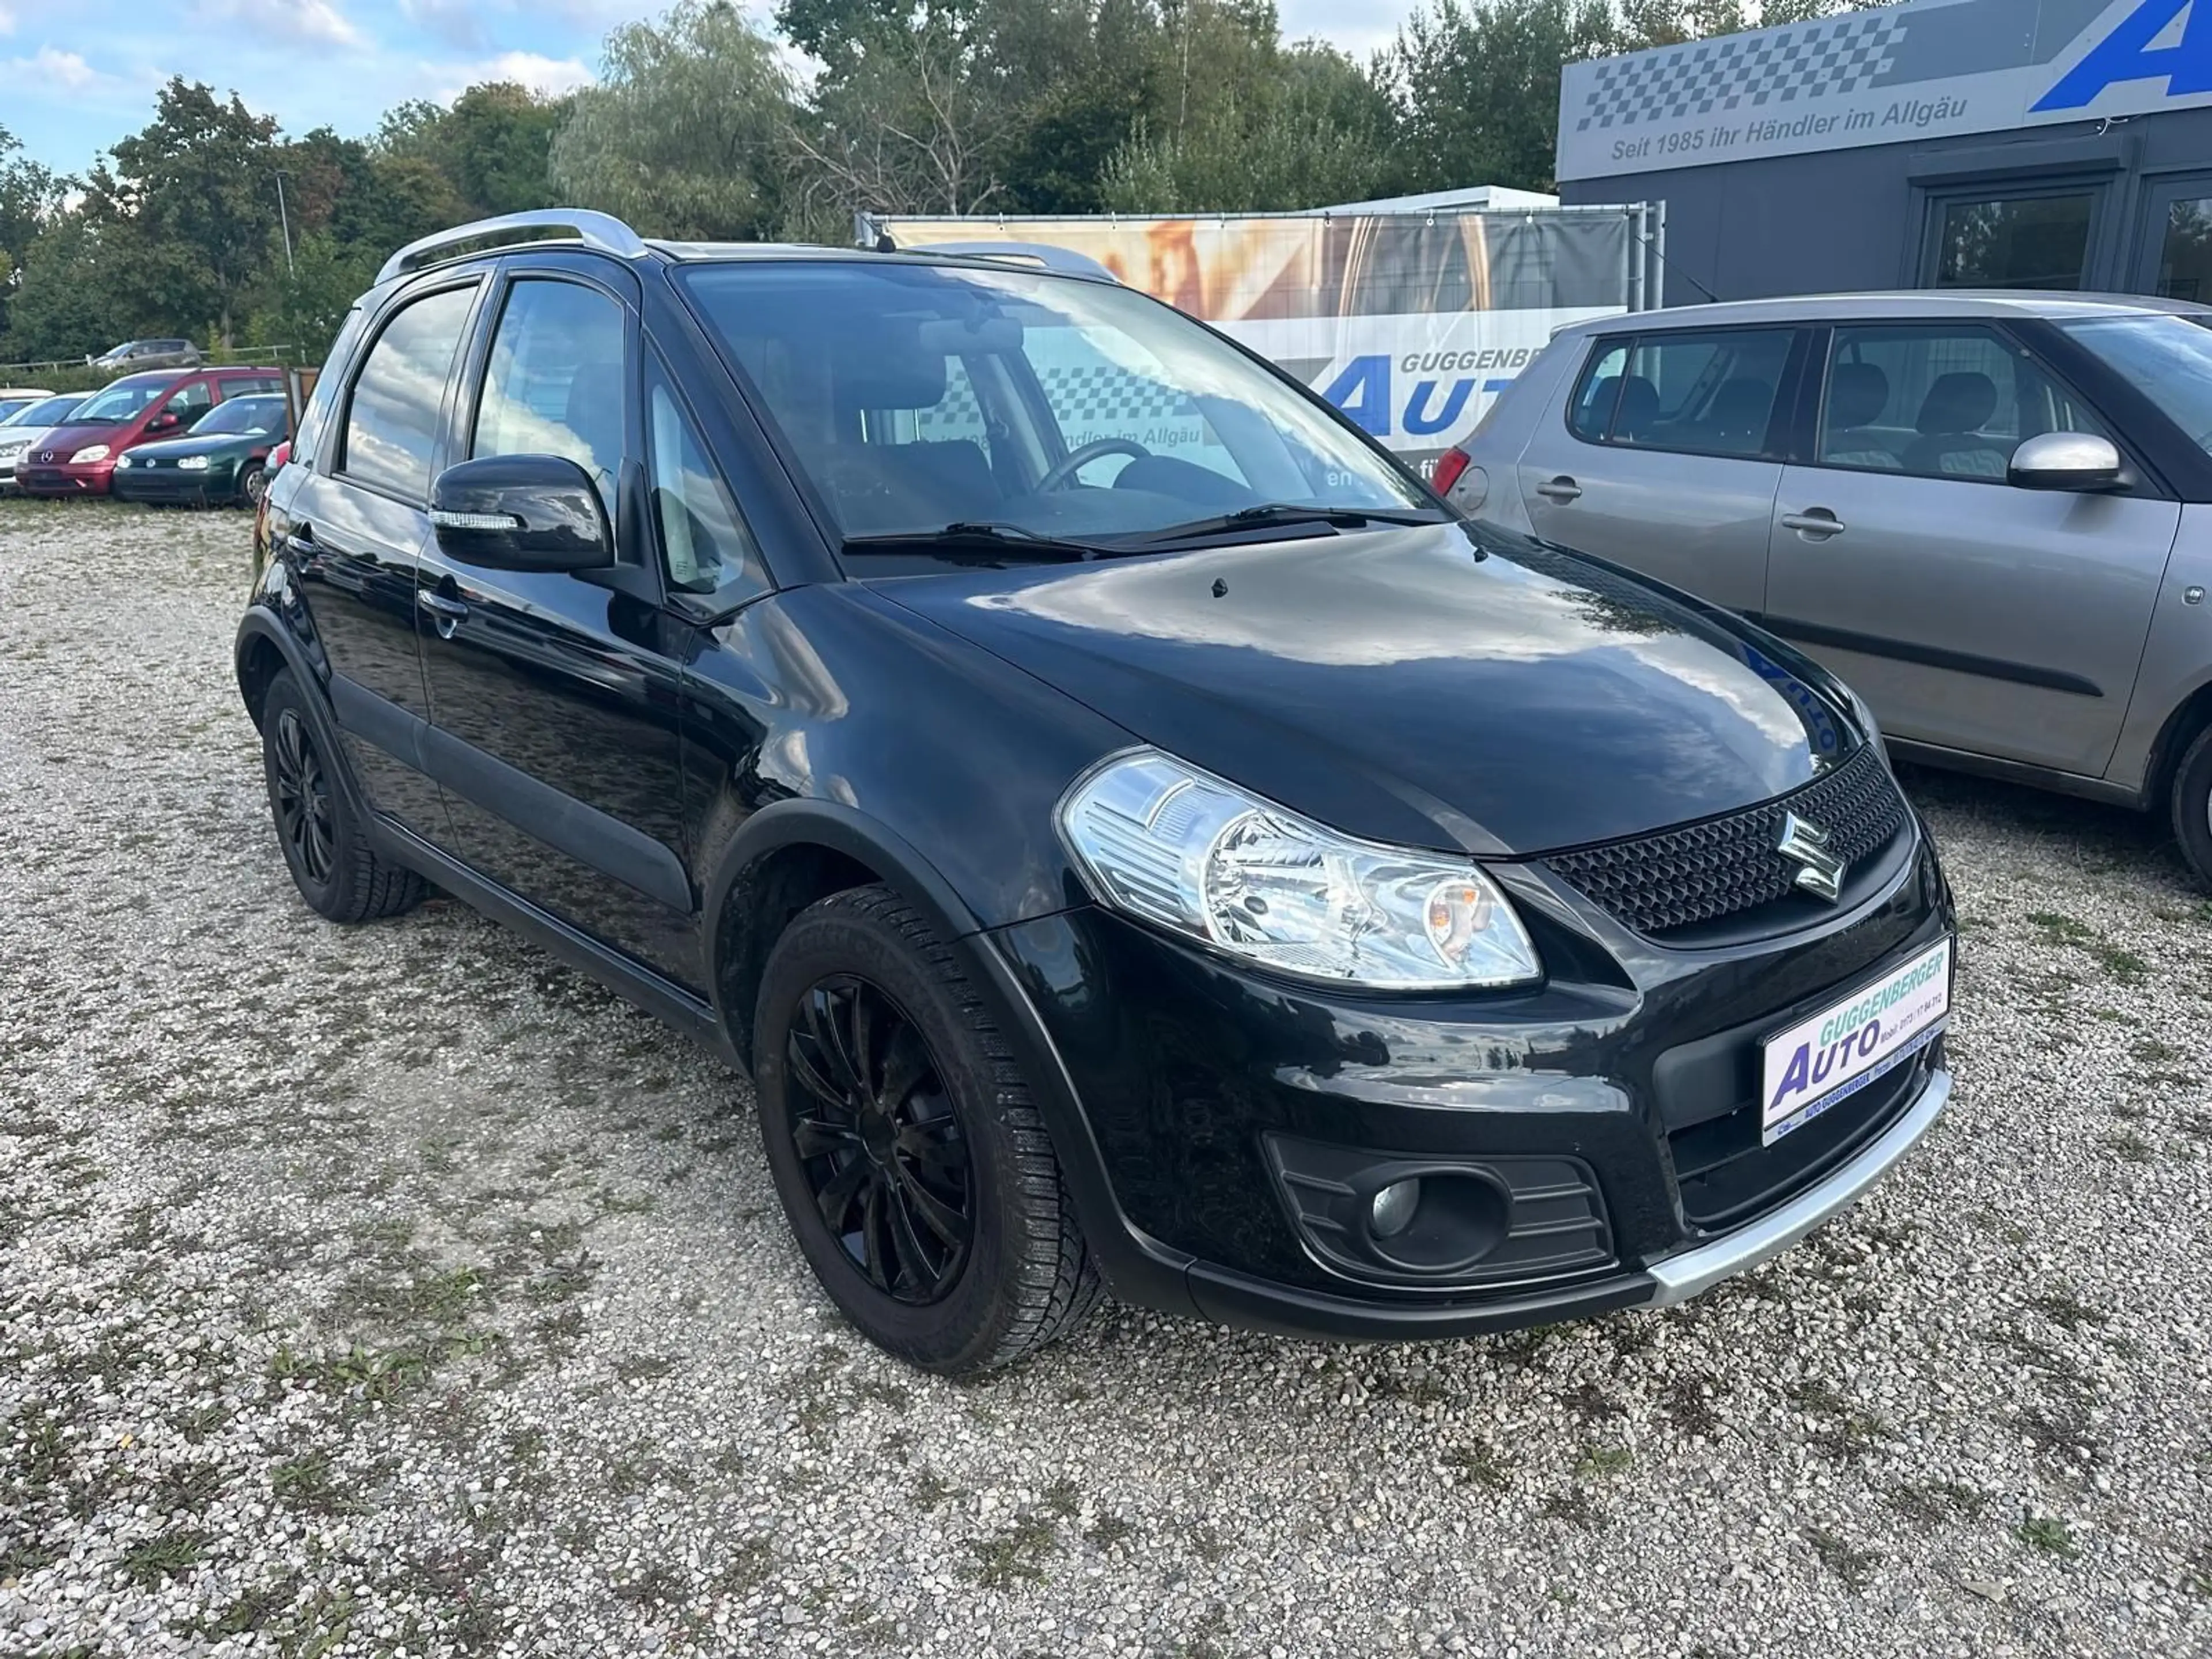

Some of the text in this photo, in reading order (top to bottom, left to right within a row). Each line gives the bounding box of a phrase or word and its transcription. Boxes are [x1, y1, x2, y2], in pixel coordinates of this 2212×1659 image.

[1612, 96, 1968, 160] Seit 1985 ihr Händler im Allgäu
[1142, 427, 1200, 448] Allgäu
[1819, 950, 1944, 1048] GUGGENBERGER
[1768, 1018, 1880, 1111] AUTO
